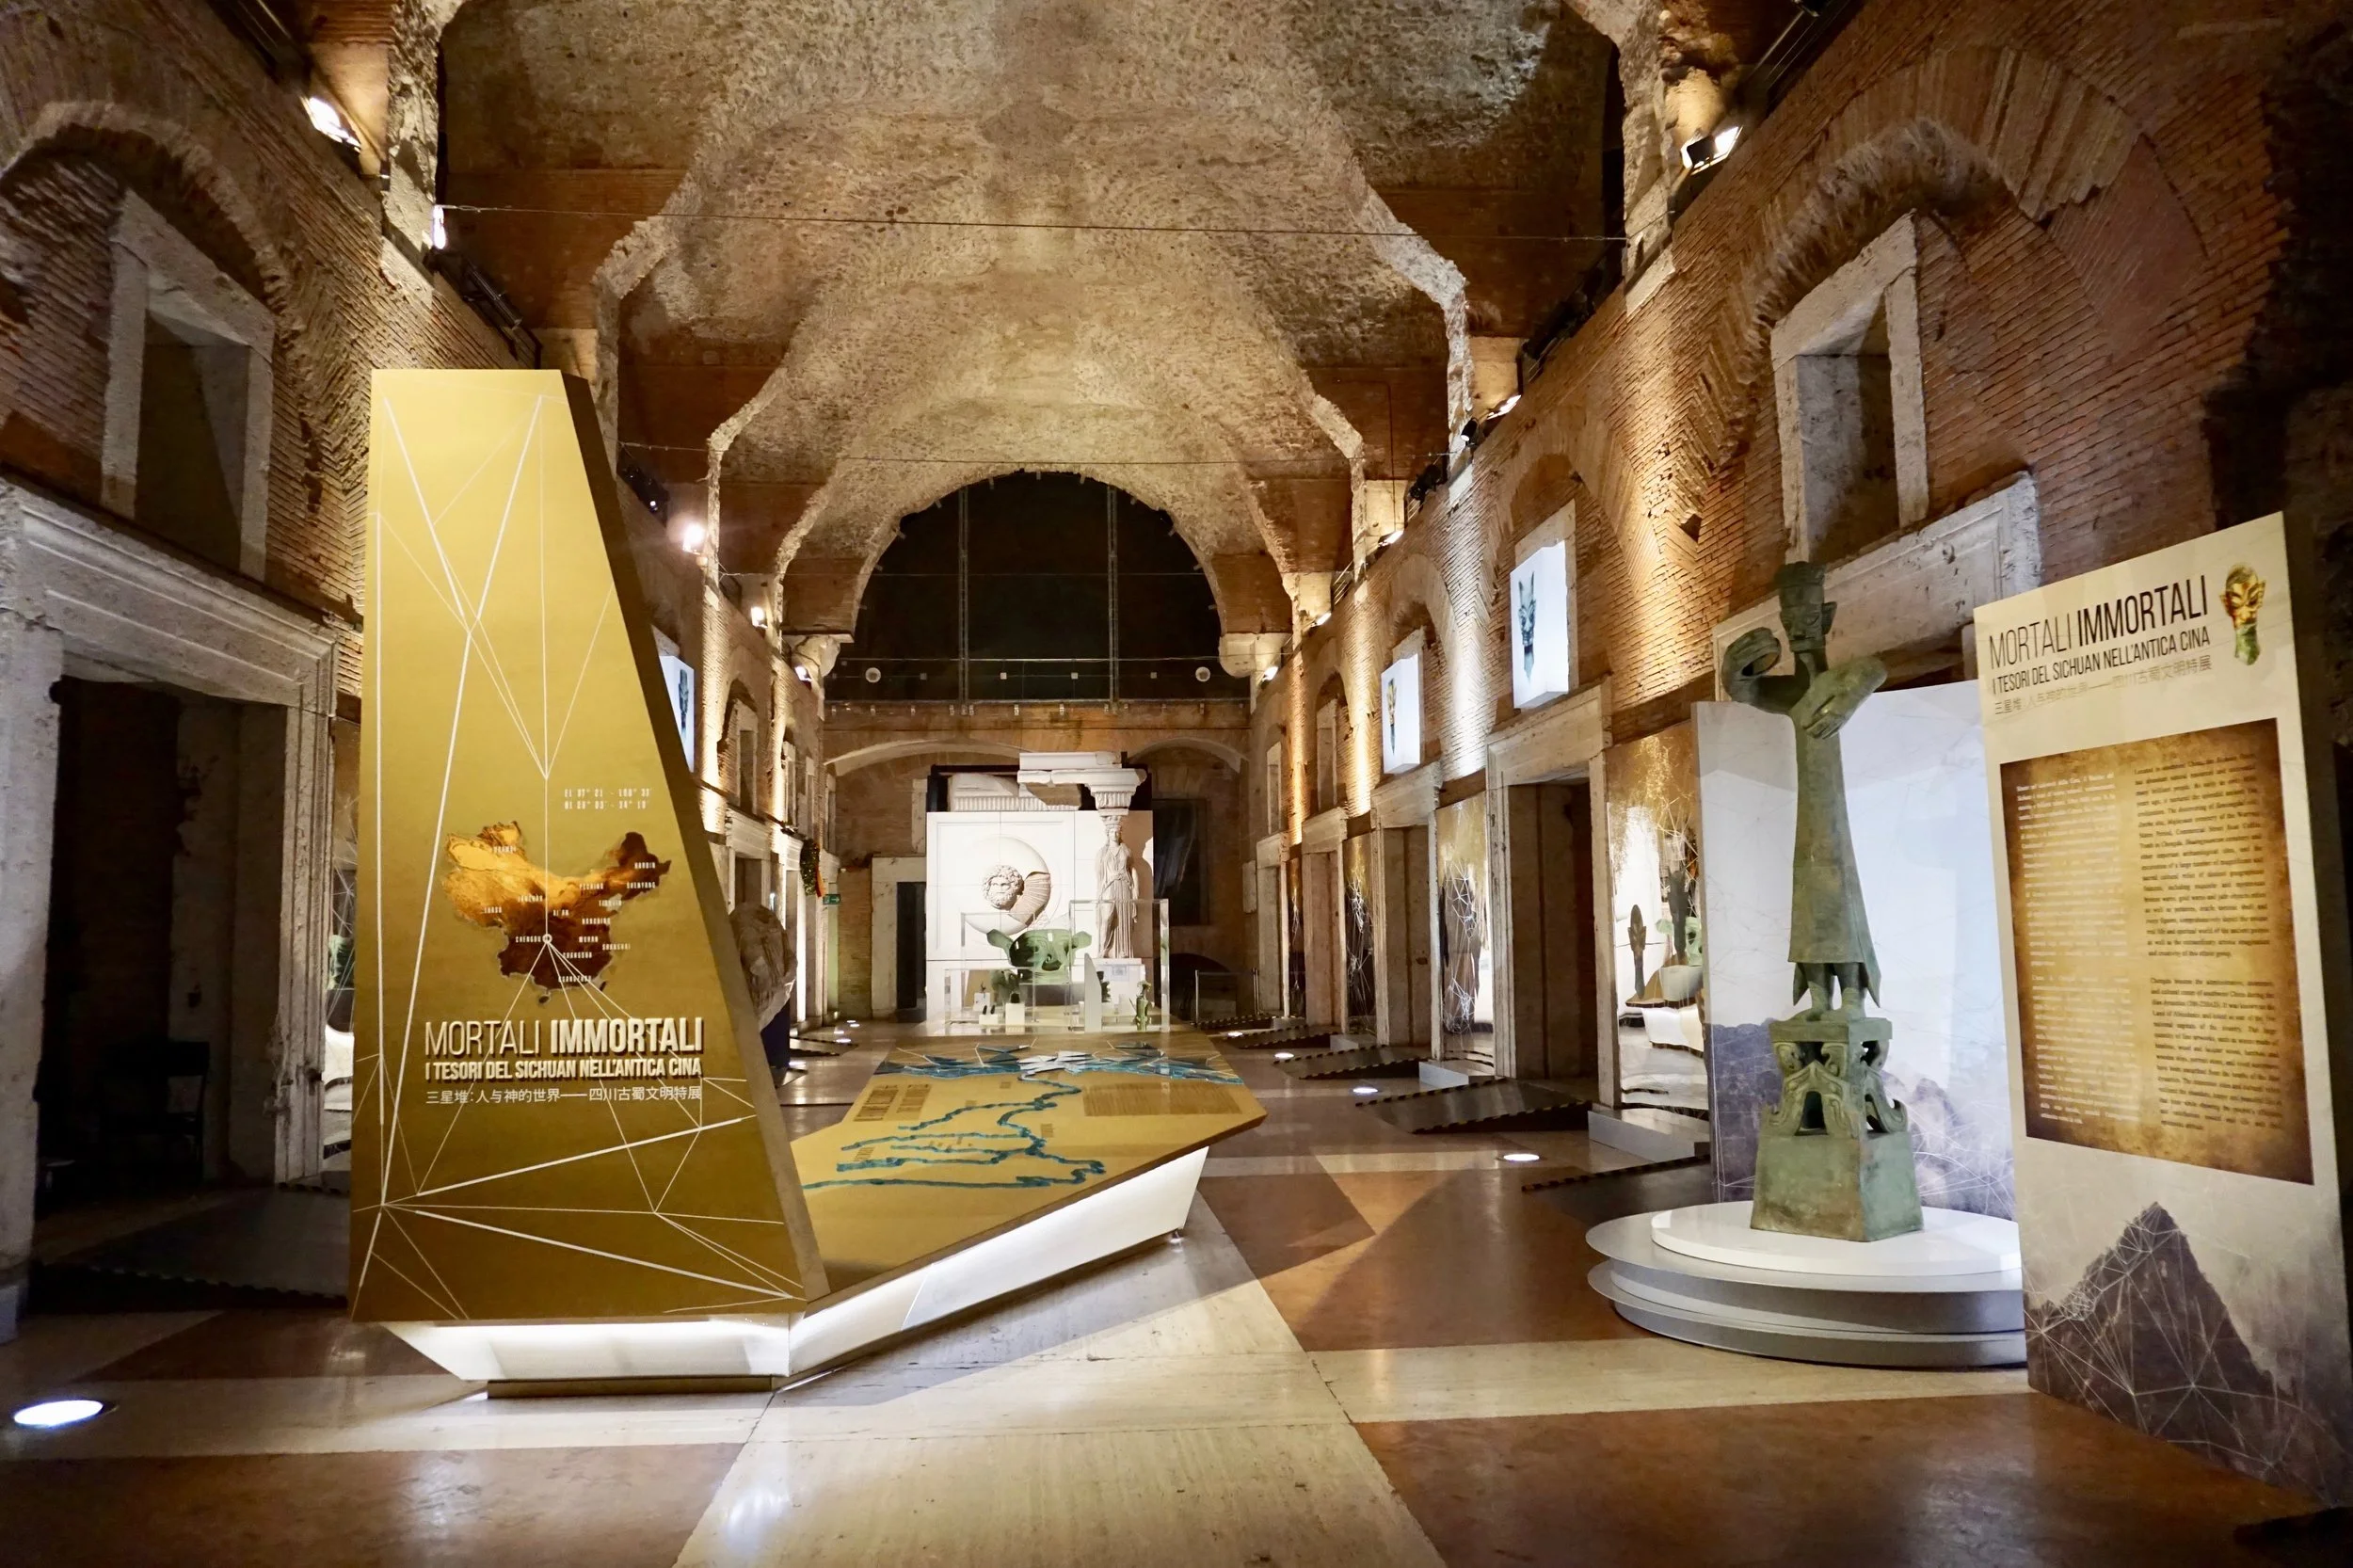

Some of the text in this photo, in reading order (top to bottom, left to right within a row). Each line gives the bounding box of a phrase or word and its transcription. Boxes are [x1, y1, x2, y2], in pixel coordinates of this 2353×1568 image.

[1990, 575, 2208, 669] MORTALI IMMORTALI
[1997, 669, 2030, 693] TESORI
[2032, 664, 2050, 685] DEL
[2053, 651, 2101, 680] SICHUAN
[2103, 633, 2178, 669] NELL'ANTICA
[2180, 626, 2211, 651] CINA
[425, 1016, 702, 1056] MORTALI IMMORTALI
[425, 1057, 702, 1080] I TESORI DEL SICHUAN NELL'ANTICA CINA
